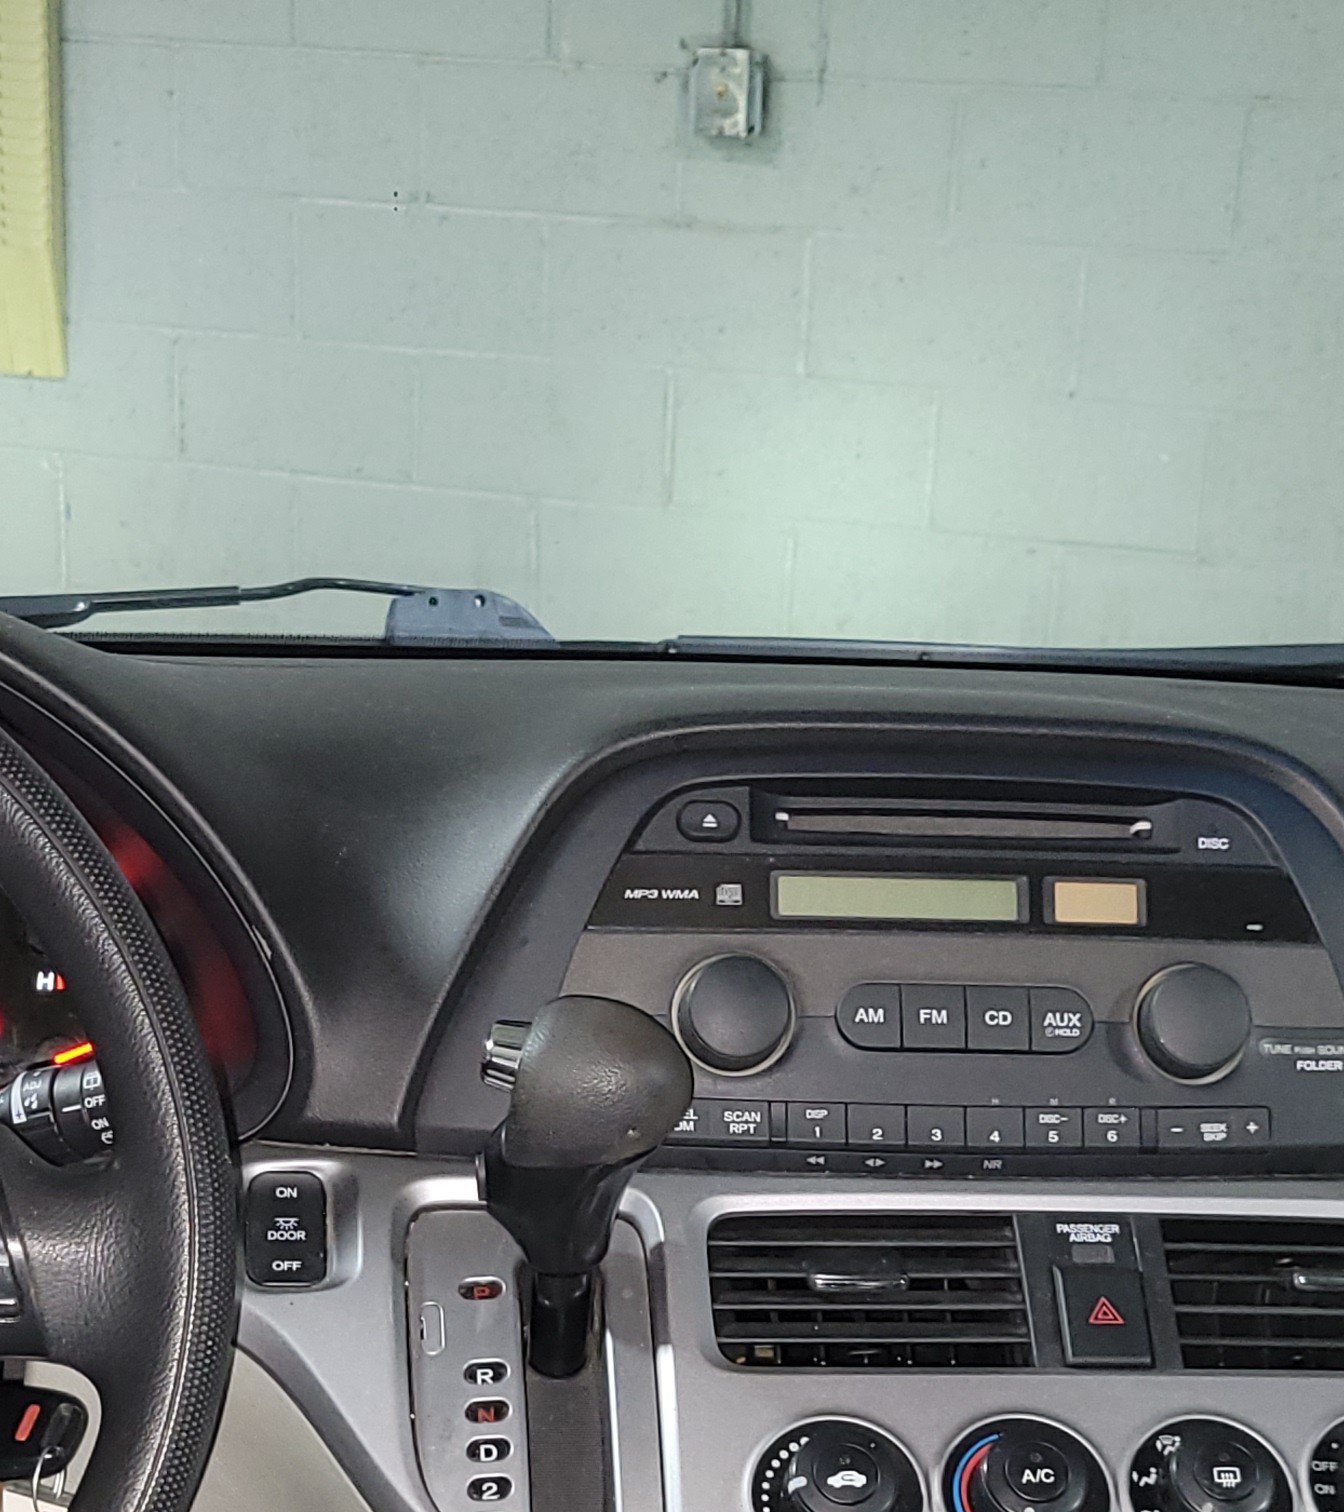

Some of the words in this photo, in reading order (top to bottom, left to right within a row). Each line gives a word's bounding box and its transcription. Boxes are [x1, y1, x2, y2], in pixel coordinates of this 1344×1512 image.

[1198, 838, 1229, 849] DISC
[624, 889, 659, 899] MP3
[661, 889, 699, 899] WMA
[36, 971, 55, 991] H
[855, 1008, 884, 1022] AM
[920, 1010, 947, 1023] FM
[985, 1011, 1011, 1025] CD
[1044, 1013, 1081, 1027] AUX
[1297, 1061, 1343, 1070] FOLDER
[84, 1094, 106, 1109] OFF
[724, 1111, 761, 1123] SCAN
[91, 1117, 110, 1131] ON
[729, 1123, 757, 1135] RPT
[815, 1127, 820, 1137] 1
[873, 1129, 883, 1140] 2
[932, 1129, 941, 1140] 3
[990, 1131, 1000, 1142] 4
[1049, 1131, 1058, 1142] 5
[1107, 1131, 1117, 1142] 6
[276, 1187, 297, 1197] ON
[1056, 1223, 1120, 1234] PASSENGER
[268, 1231, 305, 1240] DOOR
[1069, 1233, 1113, 1243] AIRBAG
[272, 1261, 301, 1270] OFF
[473, 1286, 491, 1299] P
[476, 1369, 493, 1385] R
[478, 1408, 494, 1423] N
[479, 1444, 498, 1461] D
[1312, 1460, 1338, 1472] OFF
[1022, 1469, 1054, 1483] A/C
[482, 1482, 500, 1500] 2
[1314, 1482, 1336, 1495] ON
